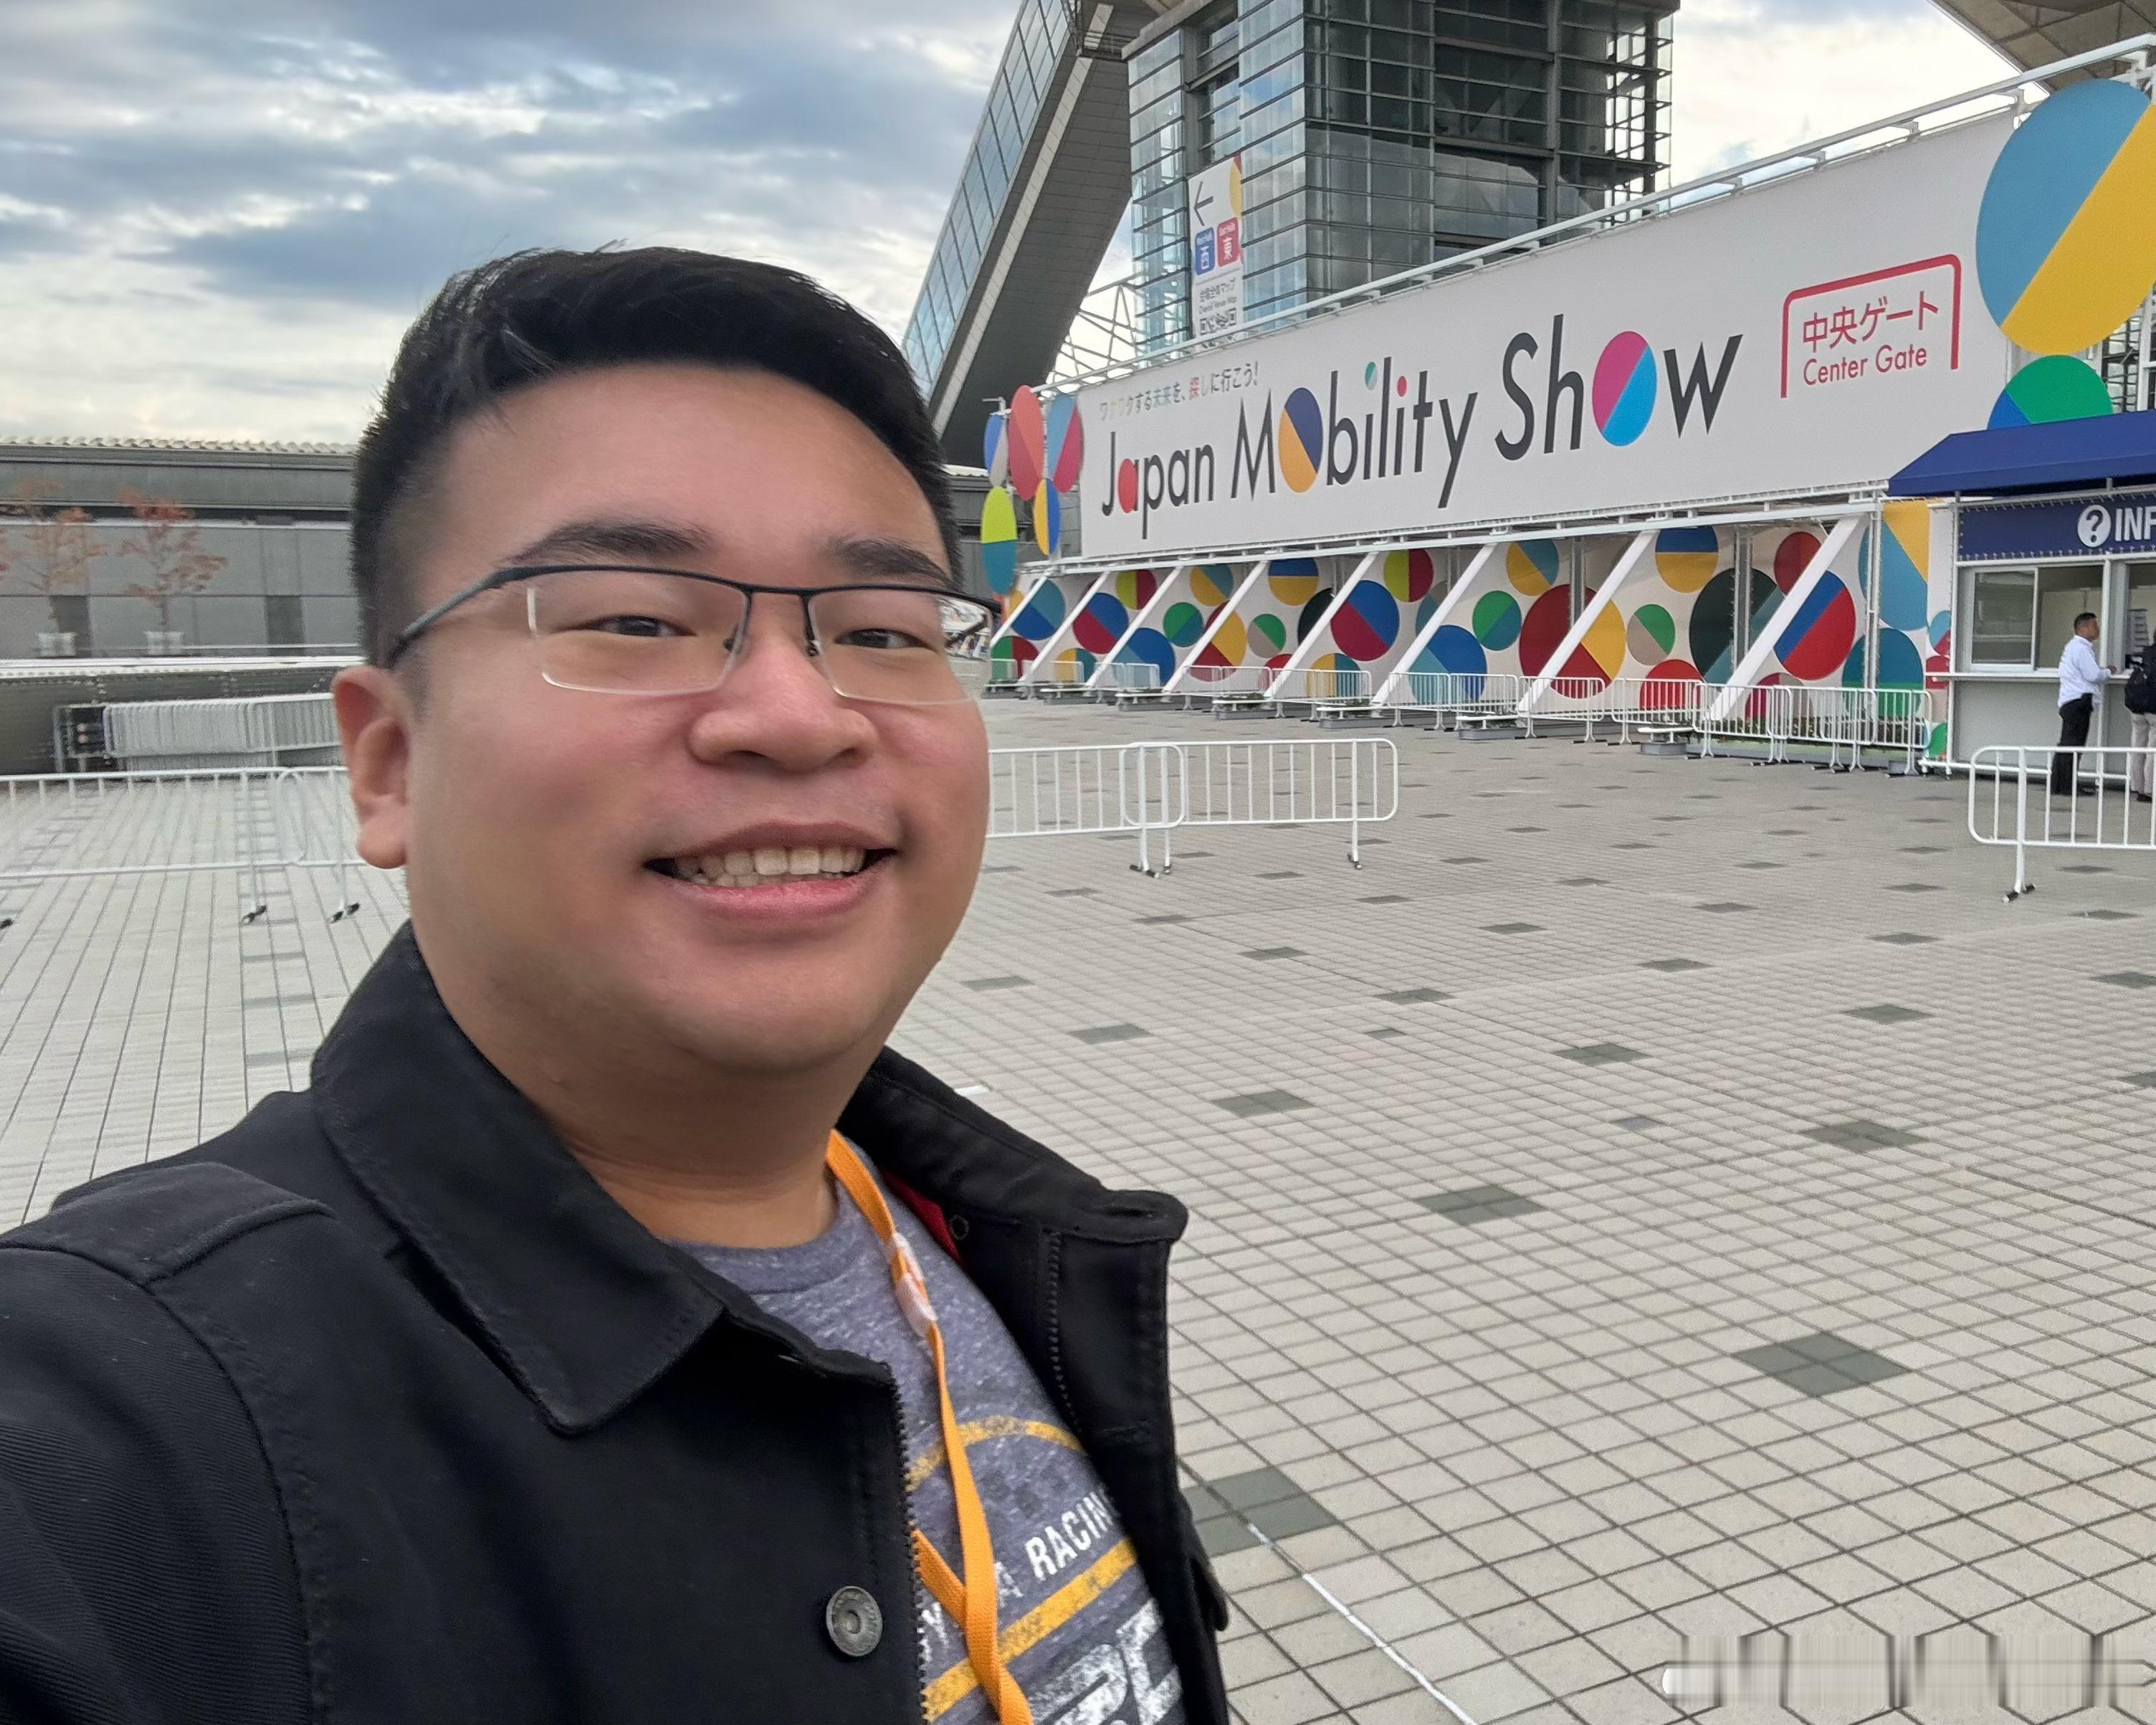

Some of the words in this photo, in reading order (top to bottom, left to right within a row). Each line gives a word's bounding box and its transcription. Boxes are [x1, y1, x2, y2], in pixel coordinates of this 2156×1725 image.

[1803, 290, 1939, 353] 中央ゲート
[1803, 356, 1868, 386] Center
[1876, 344, 1927, 374] Gate
[1102, 432, 1215, 540] Japan
[1231, 356, 1478, 508] Mobility
[1494, 314, 1744, 461] Show
